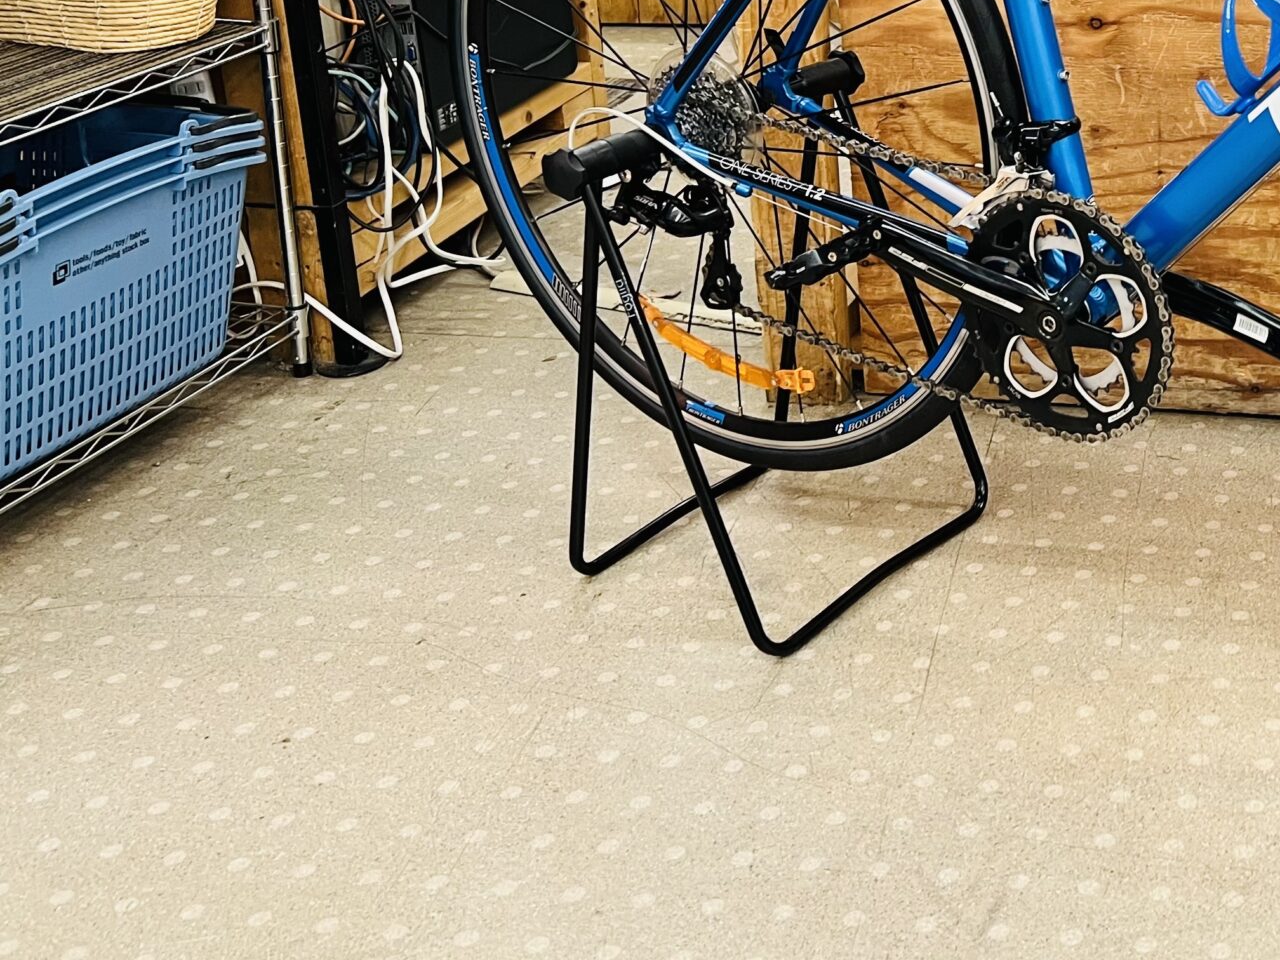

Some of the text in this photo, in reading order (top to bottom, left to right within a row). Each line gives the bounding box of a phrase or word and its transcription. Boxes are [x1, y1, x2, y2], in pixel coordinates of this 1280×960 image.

[469, 58, 491, 141] BONTRAGER
[720, 159, 749, 177] ONE
[804, 183, 825, 201] 1.2
[847, 394, 906, 432] BONTRAGER
